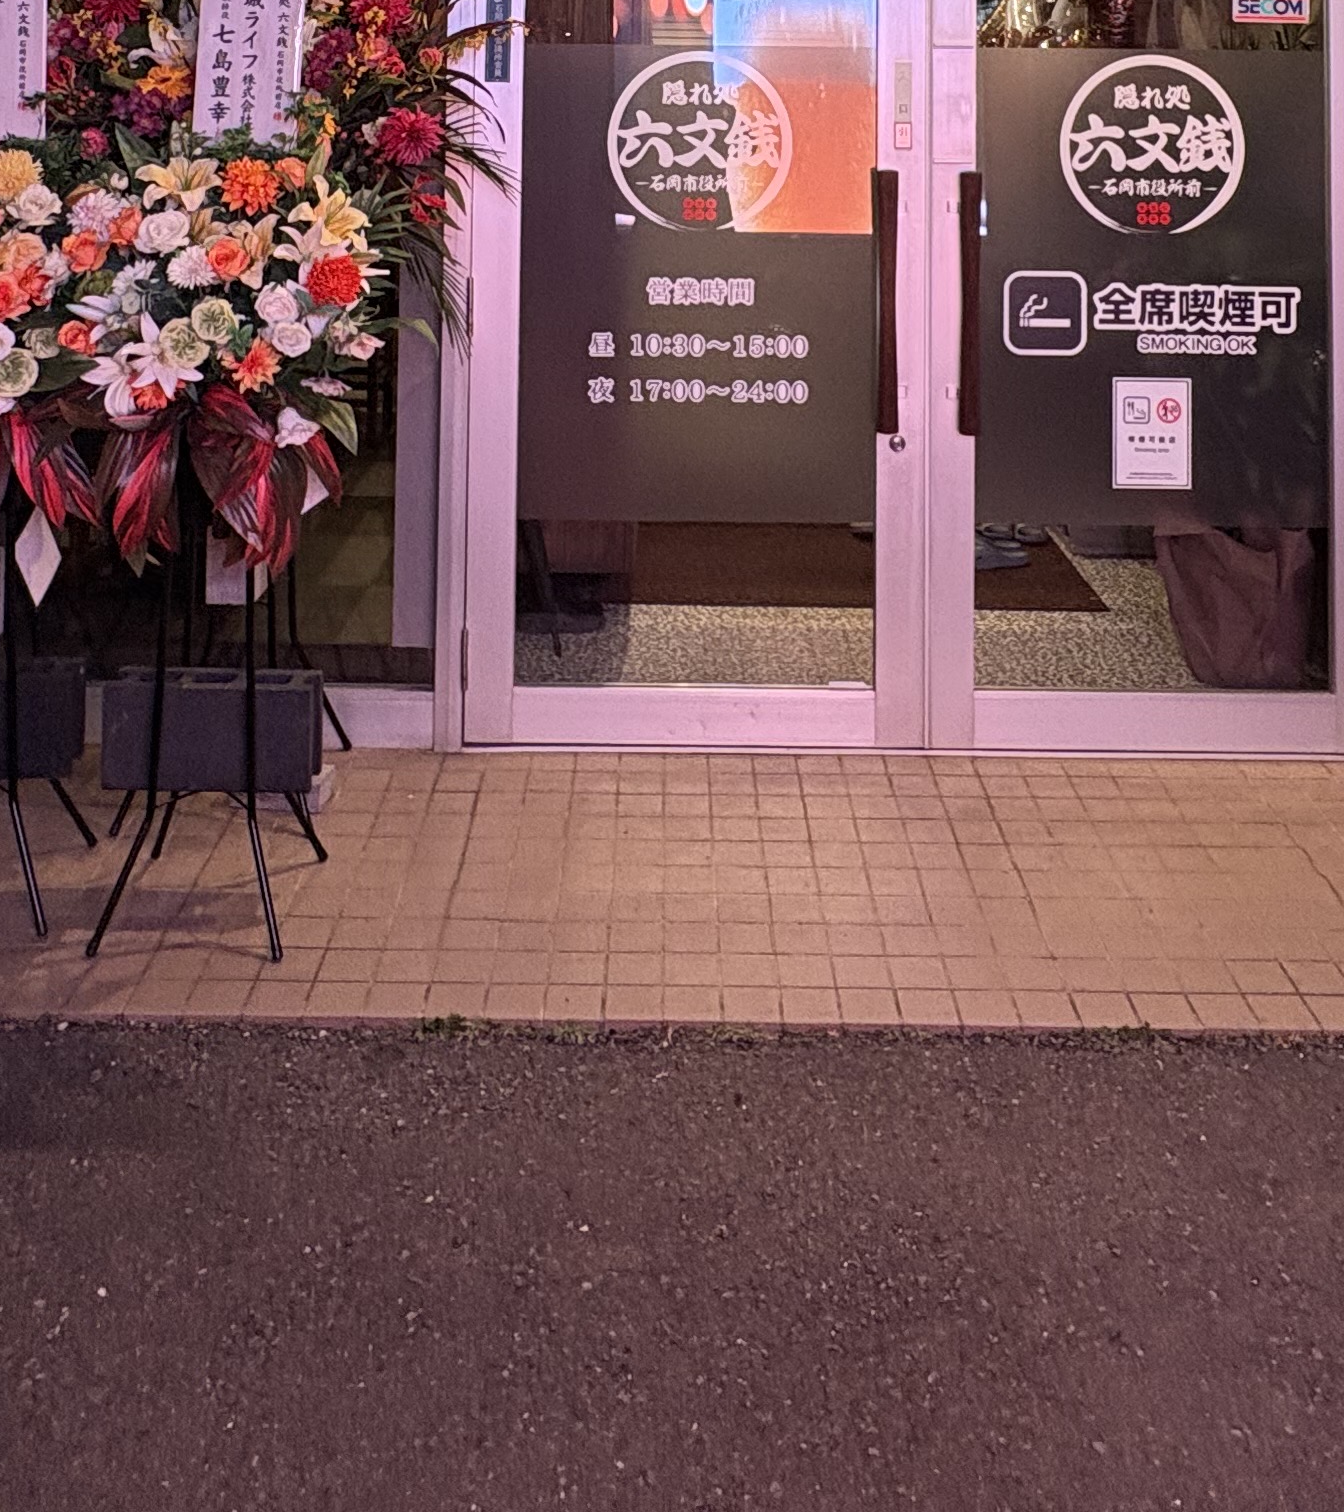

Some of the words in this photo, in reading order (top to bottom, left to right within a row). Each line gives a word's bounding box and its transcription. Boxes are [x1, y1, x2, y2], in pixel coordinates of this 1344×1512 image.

[208, 24, 235, 124] 七島豊幸
[662, 80, 739, 106] 隠れ処
[1114, 83, 1191, 110] 隠れ処
[618, 110, 780, 168] 六文銭
[1070, 113, 1233, 173] 六文銭
[1101, 178, 1202, 198] 石岡市役所前
[646, 277, 755, 306] 営業時間
[1096, 285, 1298, 331] 全席喫煙可
[588, 332, 615, 358] 昼
[1138, 335, 1223, 352] SMOKING
[1226, 336, 1255, 352] OK
[588, 376, 615, 403] 夜
